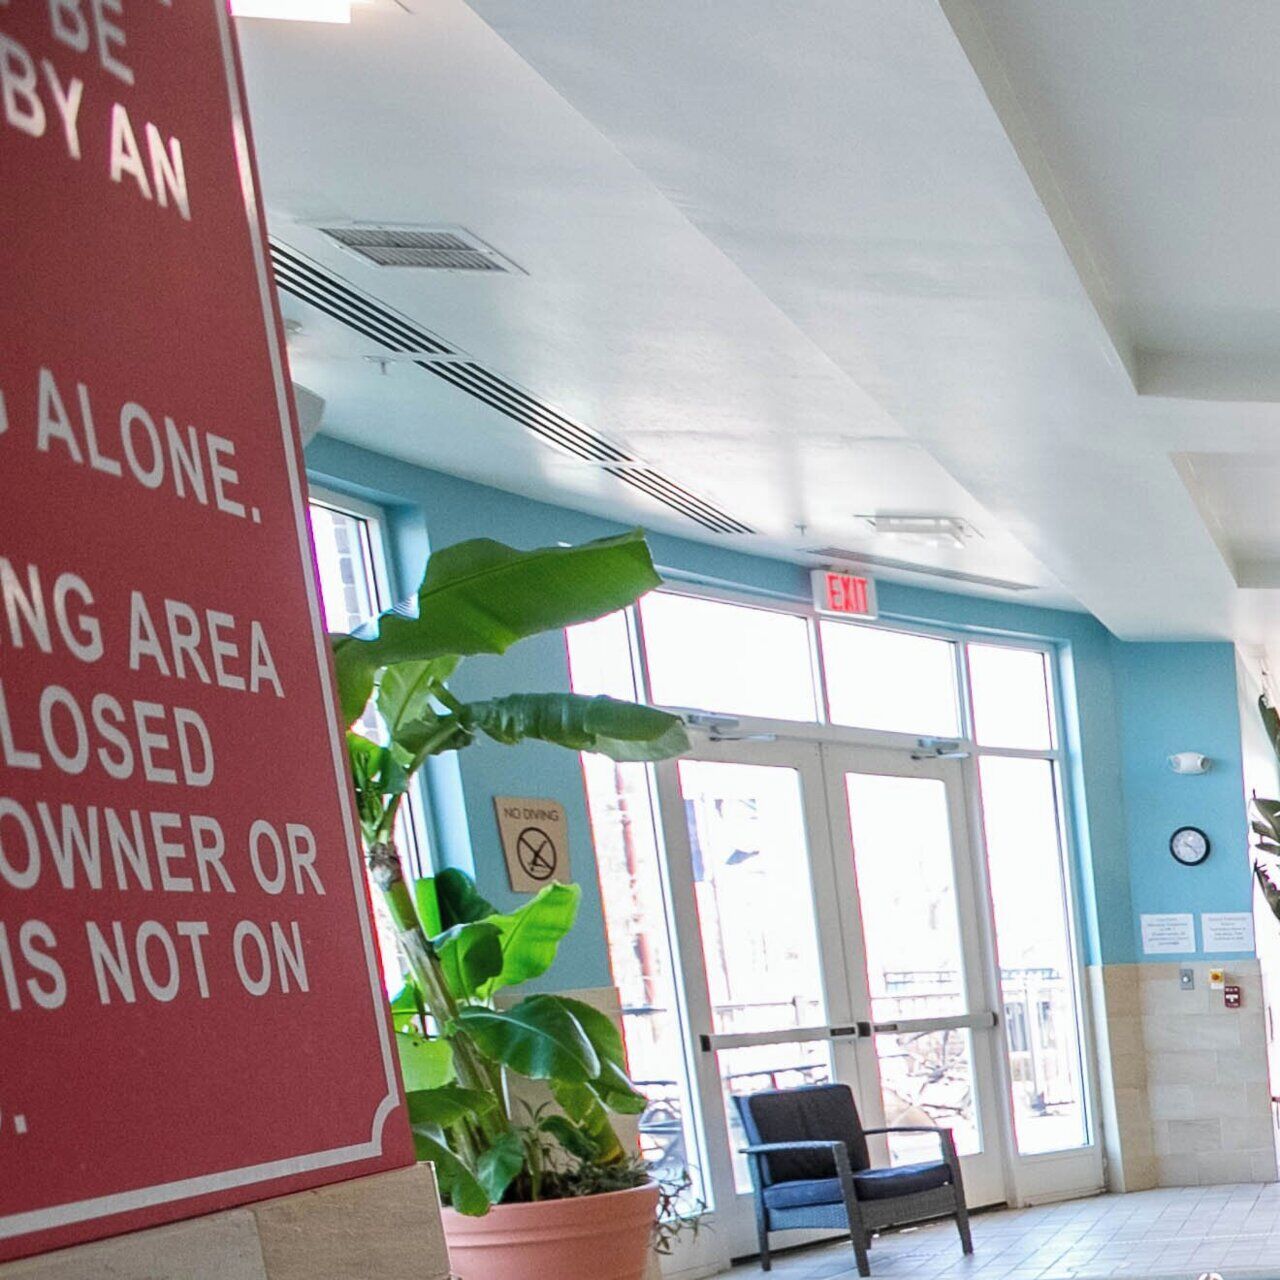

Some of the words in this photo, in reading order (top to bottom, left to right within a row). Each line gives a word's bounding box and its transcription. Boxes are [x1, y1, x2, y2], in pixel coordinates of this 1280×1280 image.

[0, 34, 84, 160] BY
[110, 102, 191, 221] AN
[37, 367, 261, 524] ALONE.
[130, 590, 285, 698] AREA
[825, 574, 868, 613] EXIT
[0, 684, 215, 787] LOSED
[0, 797, 236, 893] OWNER
[248, 819, 327, 896] OR
[504, 808, 520, 819] NO
[523, 808, 559, 821] DIVING
[0, 920, 67, 1010] IS
[86, 920, 210, 1005] NOT
[233, 920, 310, 996] ON
